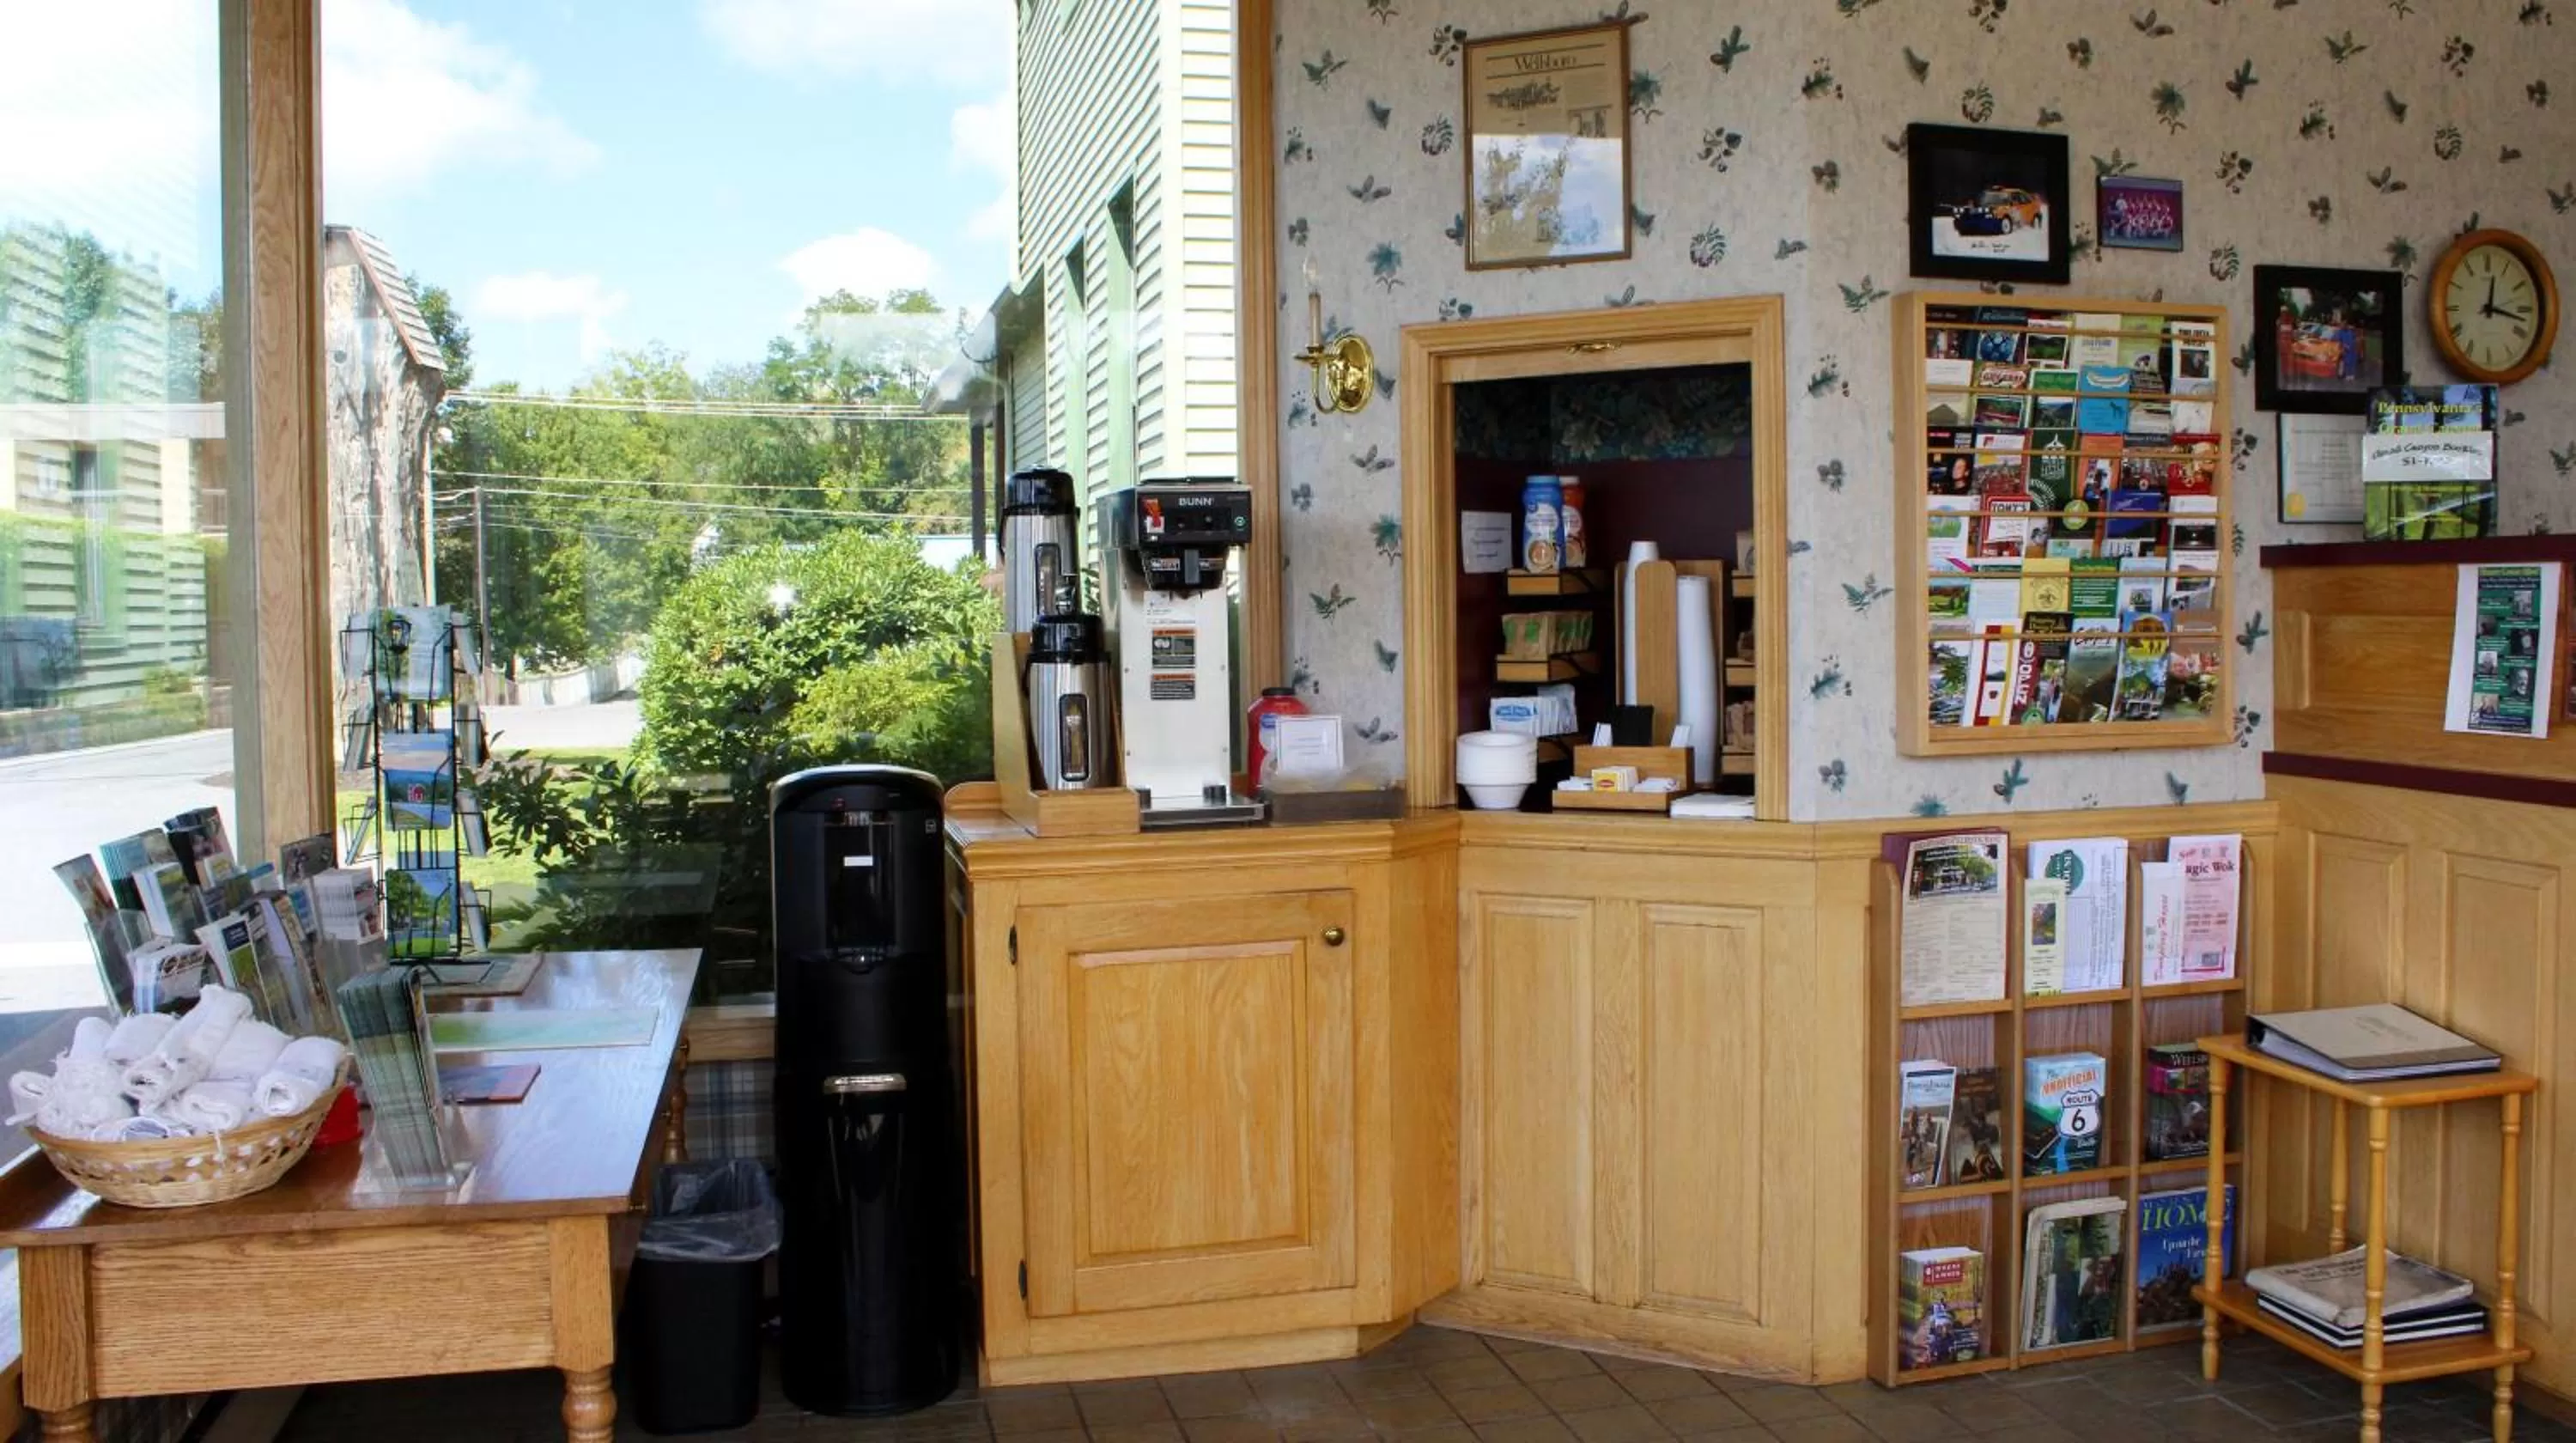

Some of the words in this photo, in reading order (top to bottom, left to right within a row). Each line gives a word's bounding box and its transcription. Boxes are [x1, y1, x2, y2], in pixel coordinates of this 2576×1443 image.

[1179, 497, 1212, 506] BUNN
[2185, 861, 2209, 876] agic
[2066, 1094, 2093, 1104] ROUTE
[2072, 1108, 2086, 1132] 6
